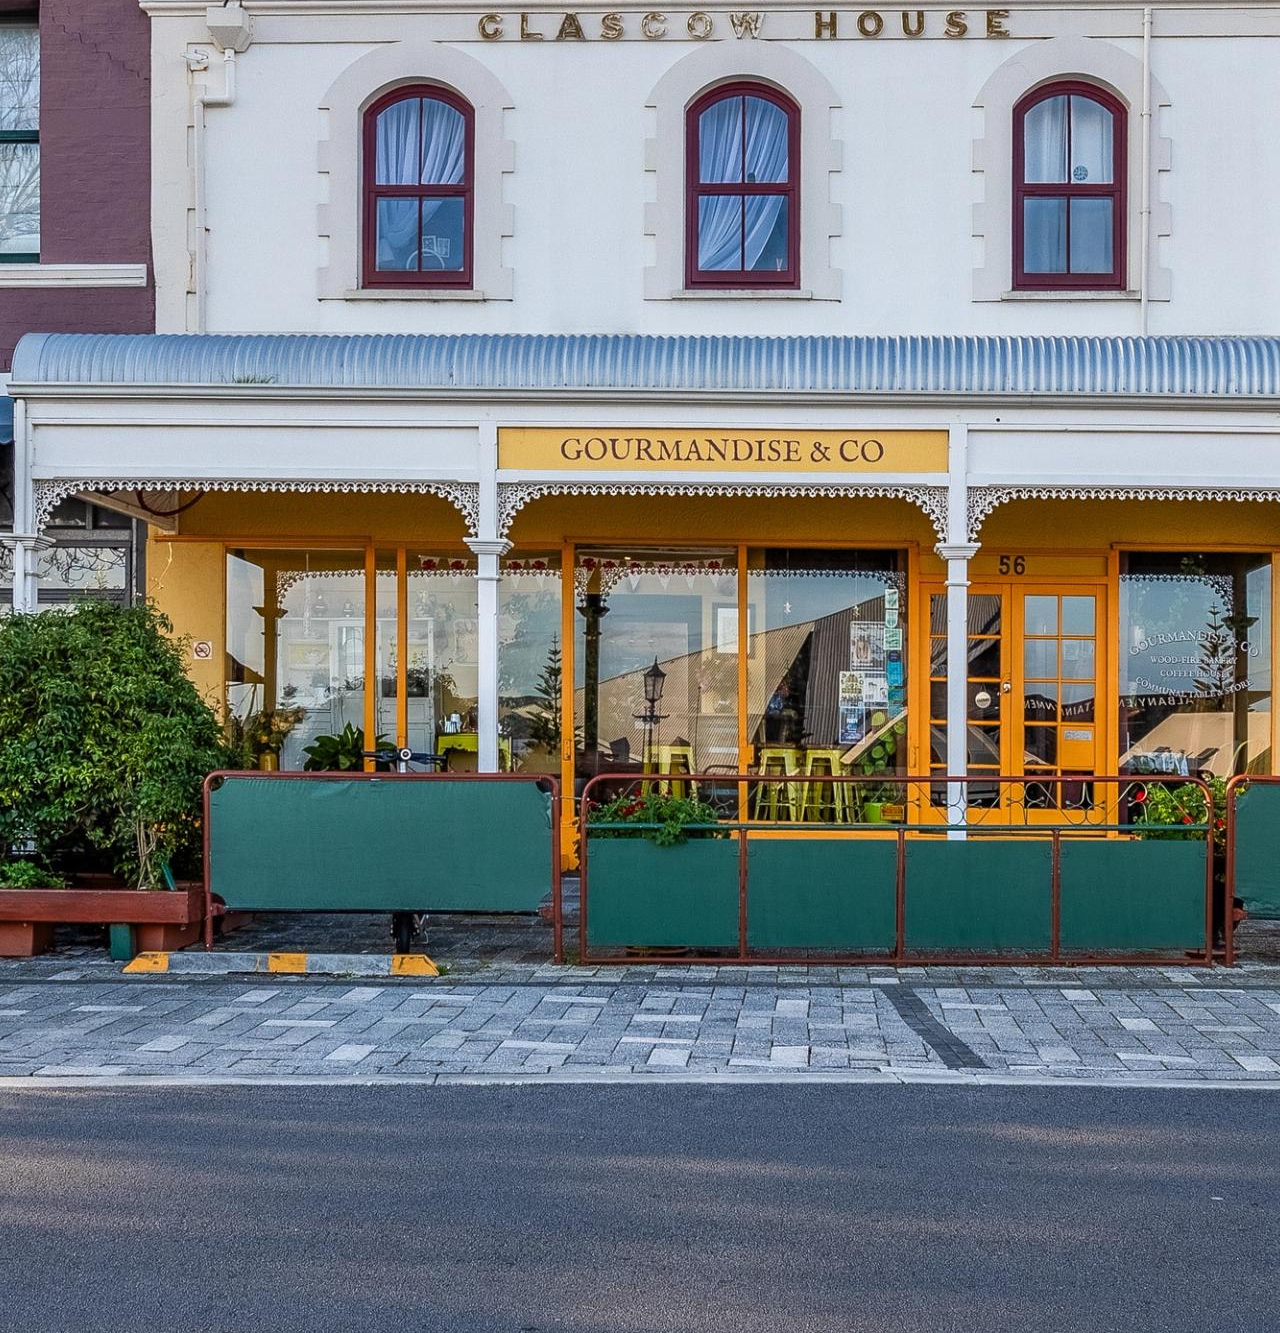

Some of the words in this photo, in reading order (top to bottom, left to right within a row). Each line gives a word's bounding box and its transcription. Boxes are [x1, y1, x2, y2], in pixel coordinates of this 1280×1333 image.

[814, 10, 1011, 40] HOUSE
[559, 438, 803, 463] GOURMANDISE
[809, 440, 831, 464] &
[838, 439, 885, 464] CO
[998, 554, 1026, 576] 56
[1129, 631, 1227, 656] GOURMANDISE
[1240, 640, 1259, 657] CO
